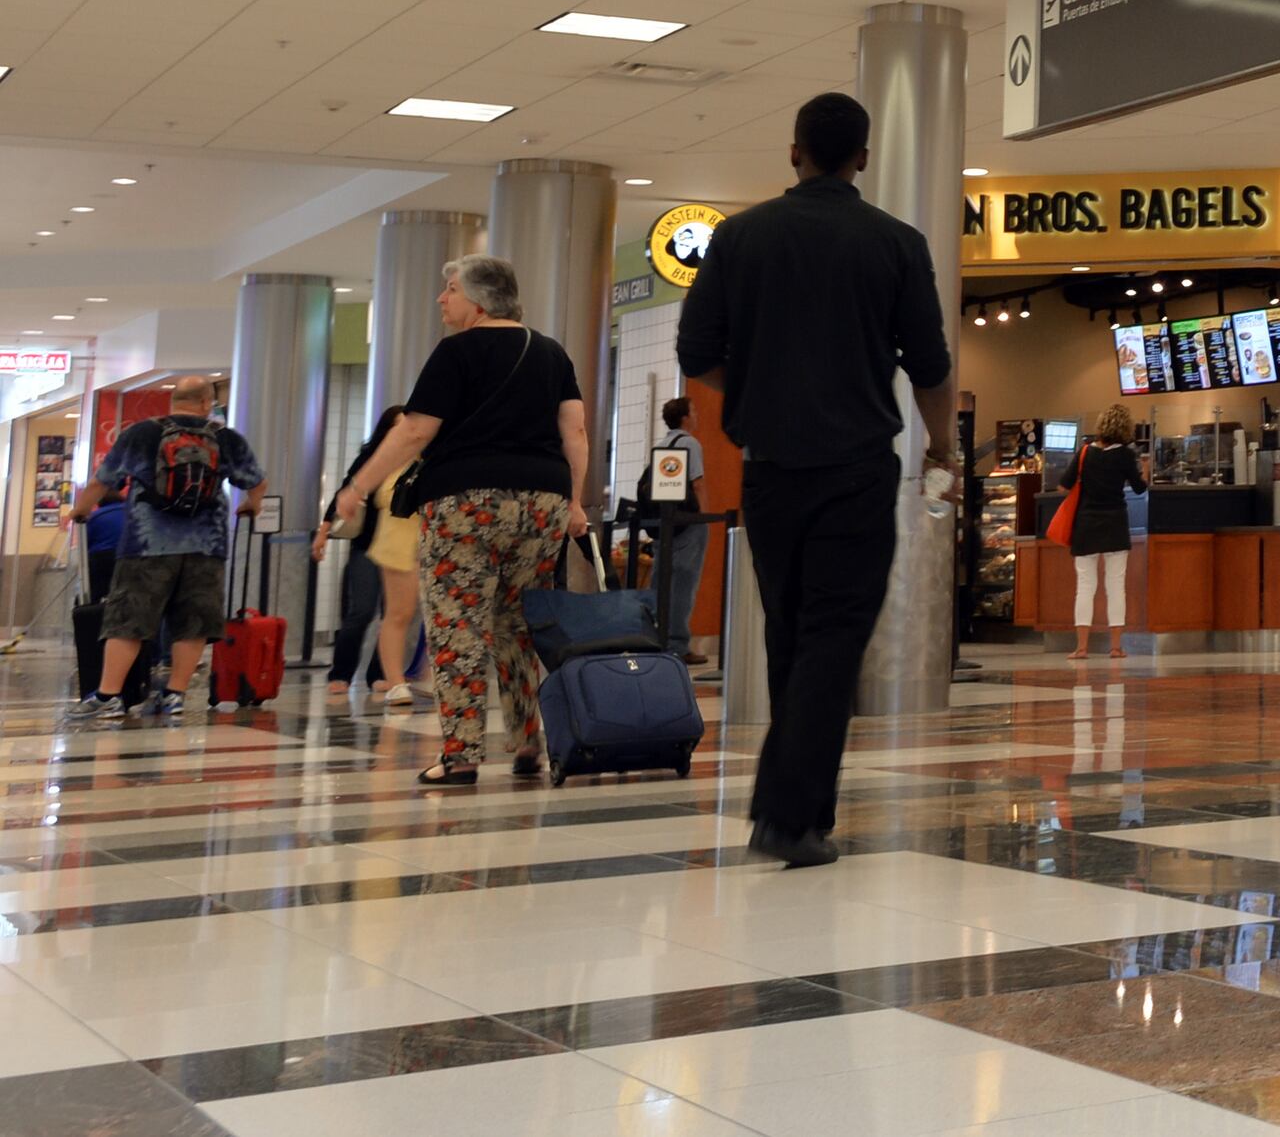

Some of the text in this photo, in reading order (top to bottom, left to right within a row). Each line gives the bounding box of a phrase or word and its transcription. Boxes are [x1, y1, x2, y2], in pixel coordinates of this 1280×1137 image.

[1063, 4, 1089, 22] Puertas
[1003, 190, 1108, 233] BROS.
[1120, 185, 1267, 230] BAGELS
[656, 208, 706, 238] EINSTEIN
[671, 267, 695, 284] BAG
